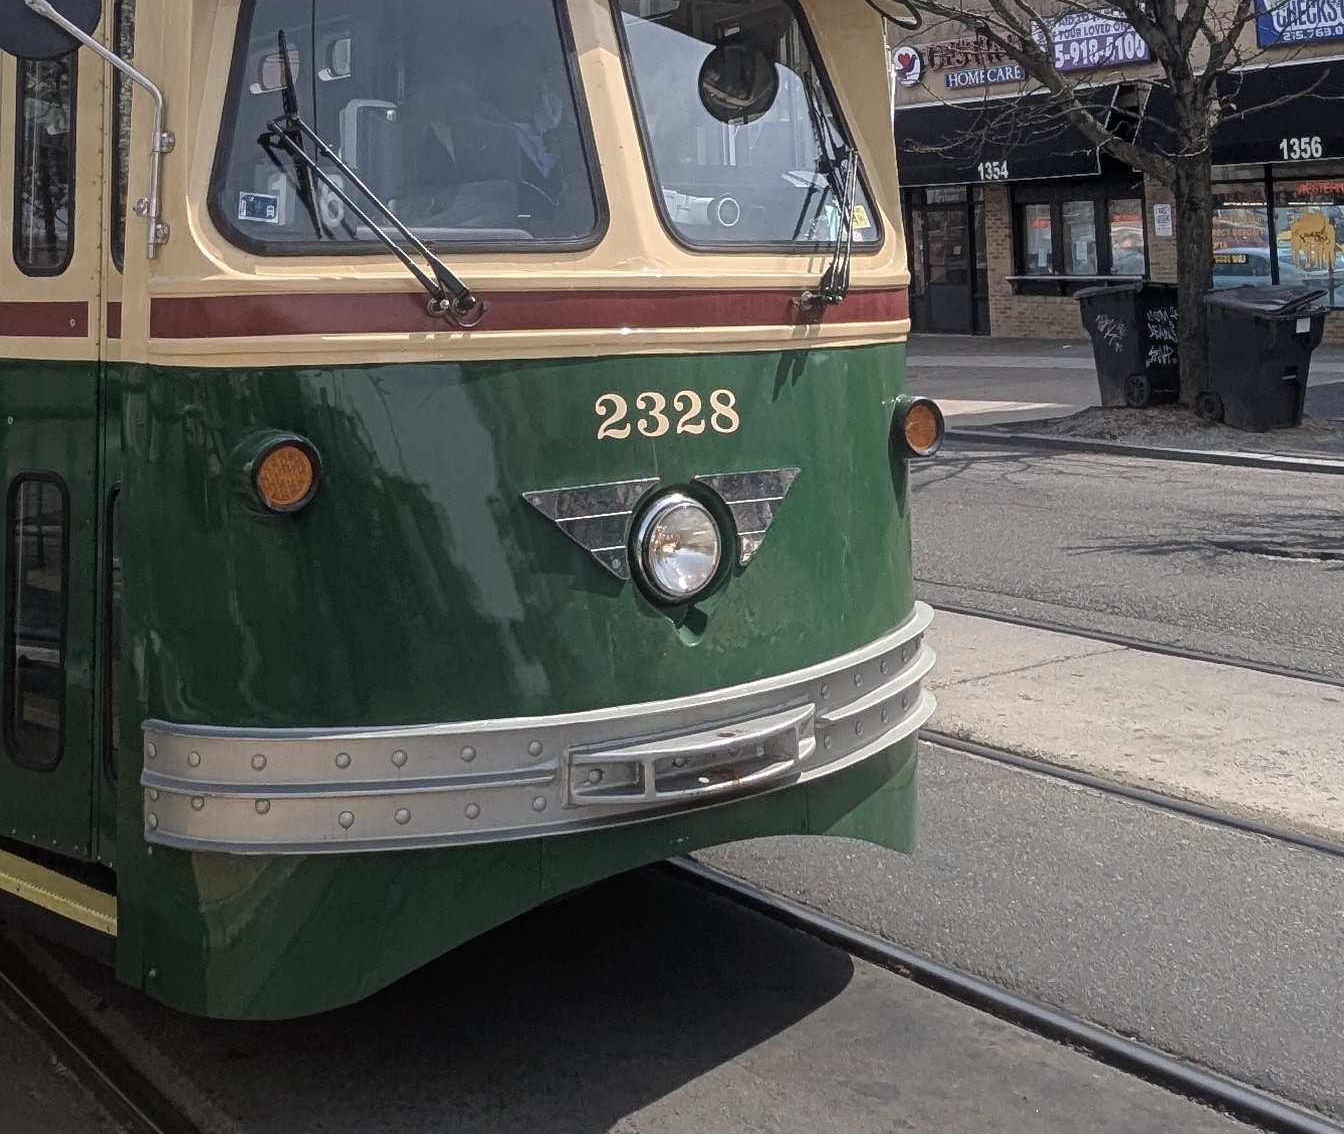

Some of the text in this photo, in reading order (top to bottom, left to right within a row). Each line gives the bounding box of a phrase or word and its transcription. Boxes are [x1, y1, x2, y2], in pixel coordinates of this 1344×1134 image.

[1084, 25, 1111, 35] LOVED
[949, 65, 1022, 85] HOME CARE
[1279, 136, 1323, 160] 1356
[977, 161, 1009, 180] 1354
[594, 388, 740, 440] 2328
